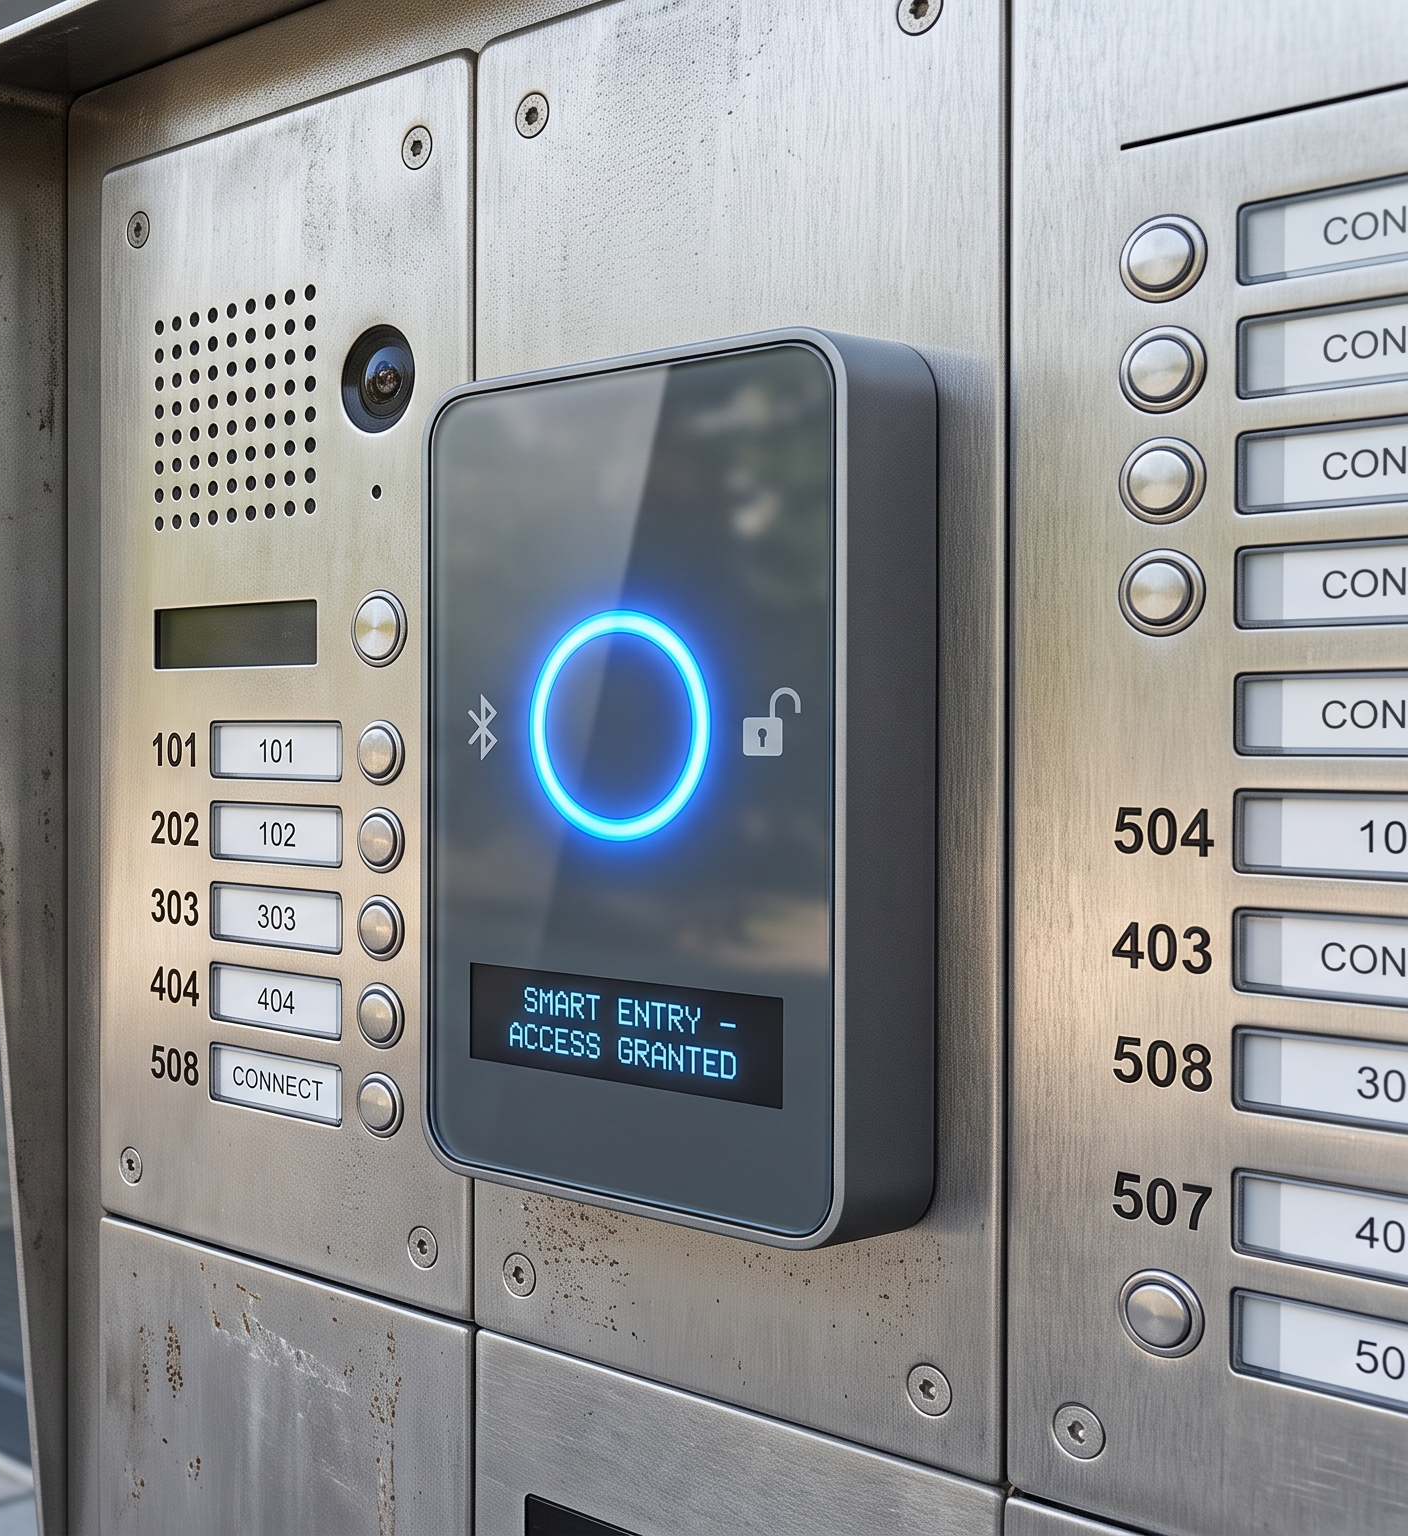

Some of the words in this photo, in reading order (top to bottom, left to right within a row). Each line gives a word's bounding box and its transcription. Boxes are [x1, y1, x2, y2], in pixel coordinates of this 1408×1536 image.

[1323, 206, 1406, 245] CON
[1323, 326, 1406, 362] CON
[1322, 446, 1406, 480] CON
[1322, 567, 1406, 599] CON
[1322, 700, 1406, 729] CON
[152, 732, 196, 767] 101
[259, 738, 294, 763] 101
[150, 810, 199, 846] 202
[259, 822, 296, 847] 102
[1114, 806, 1214, 857] 504
[1360, 820, 1407, 854] 10
[150, 888, 199, 926] 303
[257, 904, 296, 931] 303
[1112, 922, 1212, 974] 403
[1321, 942, 1406, 977] CON
[150, 966, 199, 1007] 404
[257, 987, 295, 1015] 404
[524, 987, 600, 1021] SMART
[618, 998, 701, 1034] ENTRY
[150, 1045, 199, 1087] 508
[509, 1022, 601, 1059] ACCESS
[618, 1037, 737, 1080] GRANTED
[1112, 1035, 1213, 1092] 508
[232, 1066, 323, 1101] CONNECT
[1357, 1066, 1406, 1102] 30
[1112, 1171, 1213, 1231] 507
[1355, 1217, 1406, 1253] 40
[1355, 1340, 1406, 1380] 50
